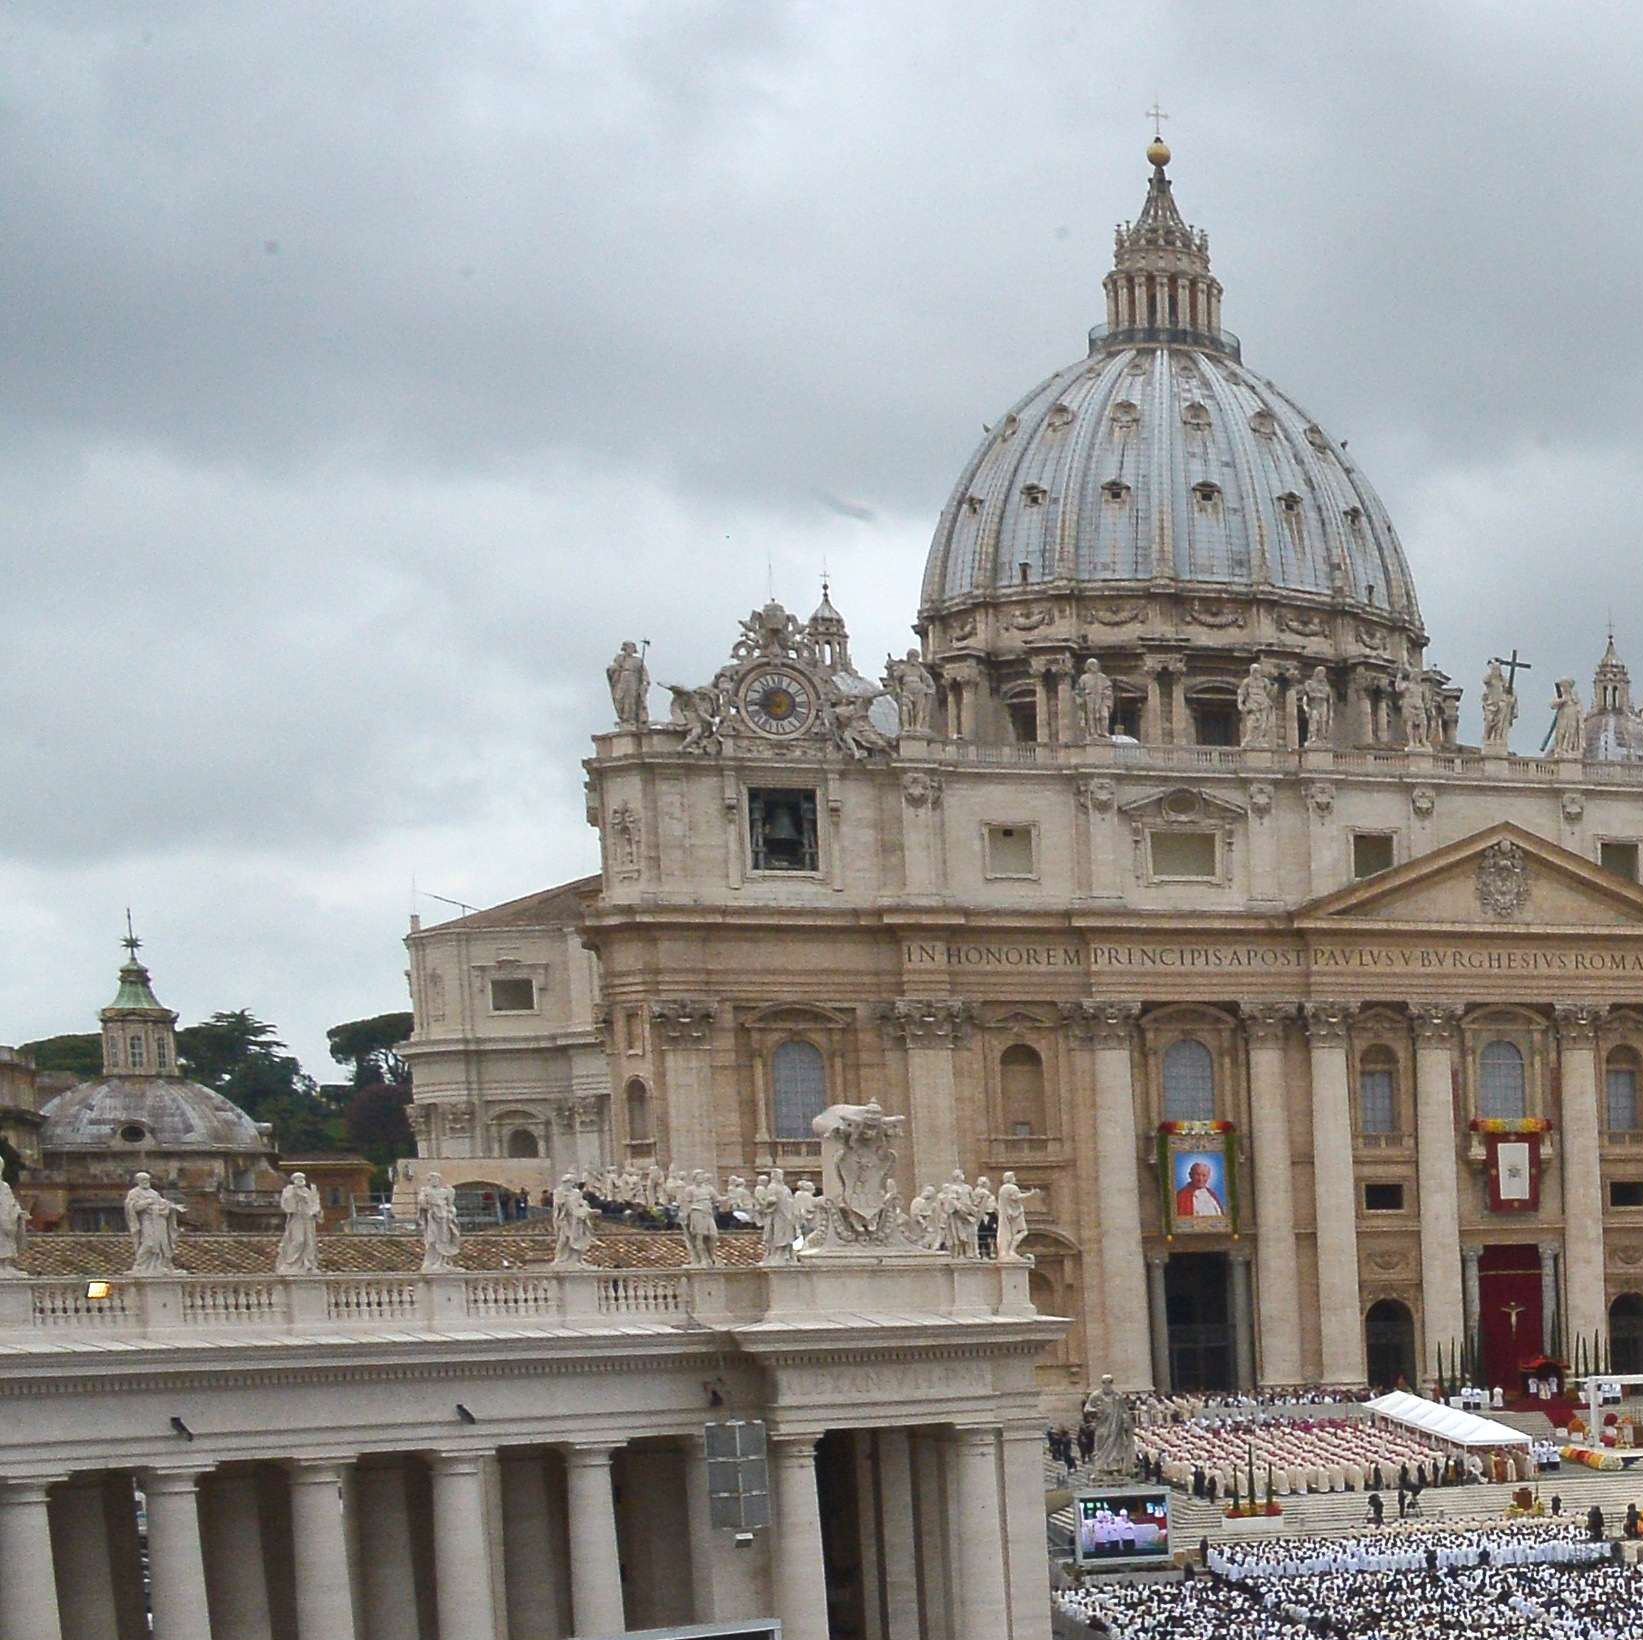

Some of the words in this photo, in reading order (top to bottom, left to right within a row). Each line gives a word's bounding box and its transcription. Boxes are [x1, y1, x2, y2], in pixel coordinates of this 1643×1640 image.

[905, 944, 937, 963] IN
[946, 945, 1082, 966] HONOREM
[1092, 946, 1227, 966] PRINCIPIS
[1229, 948, 1303, 967] APOST
[1313, 948, 1394, 967] PAVLVS
[1419, 950, 1567, 970] BVRGHESIVS
